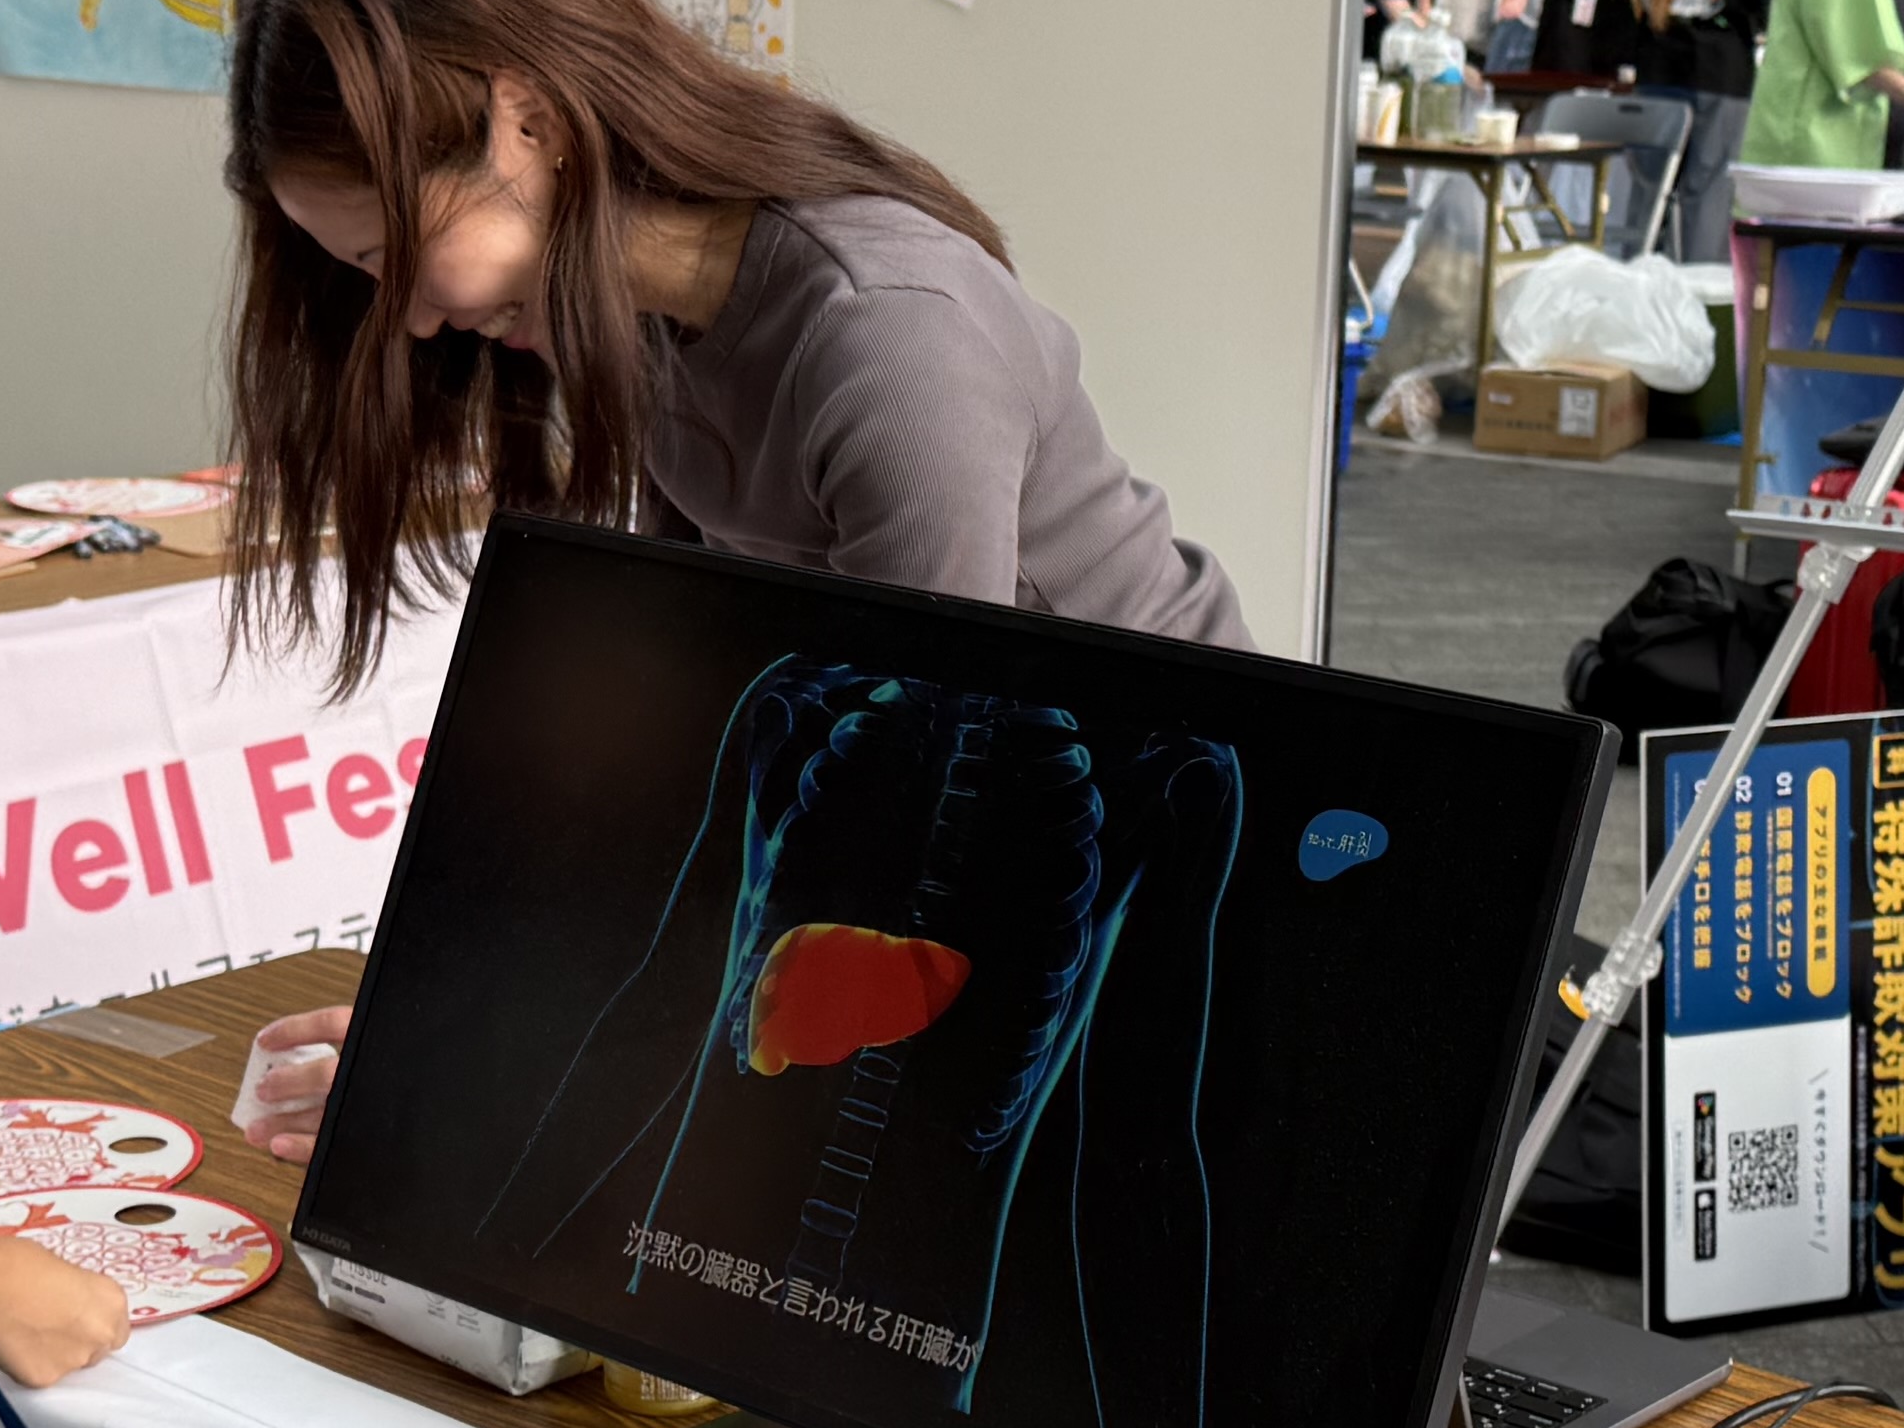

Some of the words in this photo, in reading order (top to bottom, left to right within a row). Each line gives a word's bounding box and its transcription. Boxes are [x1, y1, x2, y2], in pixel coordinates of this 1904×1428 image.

[1735, 776, 1752, 804] 02
[1776, 771, 1793, 797] 01
[622, 1219, 983, 1372] 沈黙の臓器と言われる肝臓が
